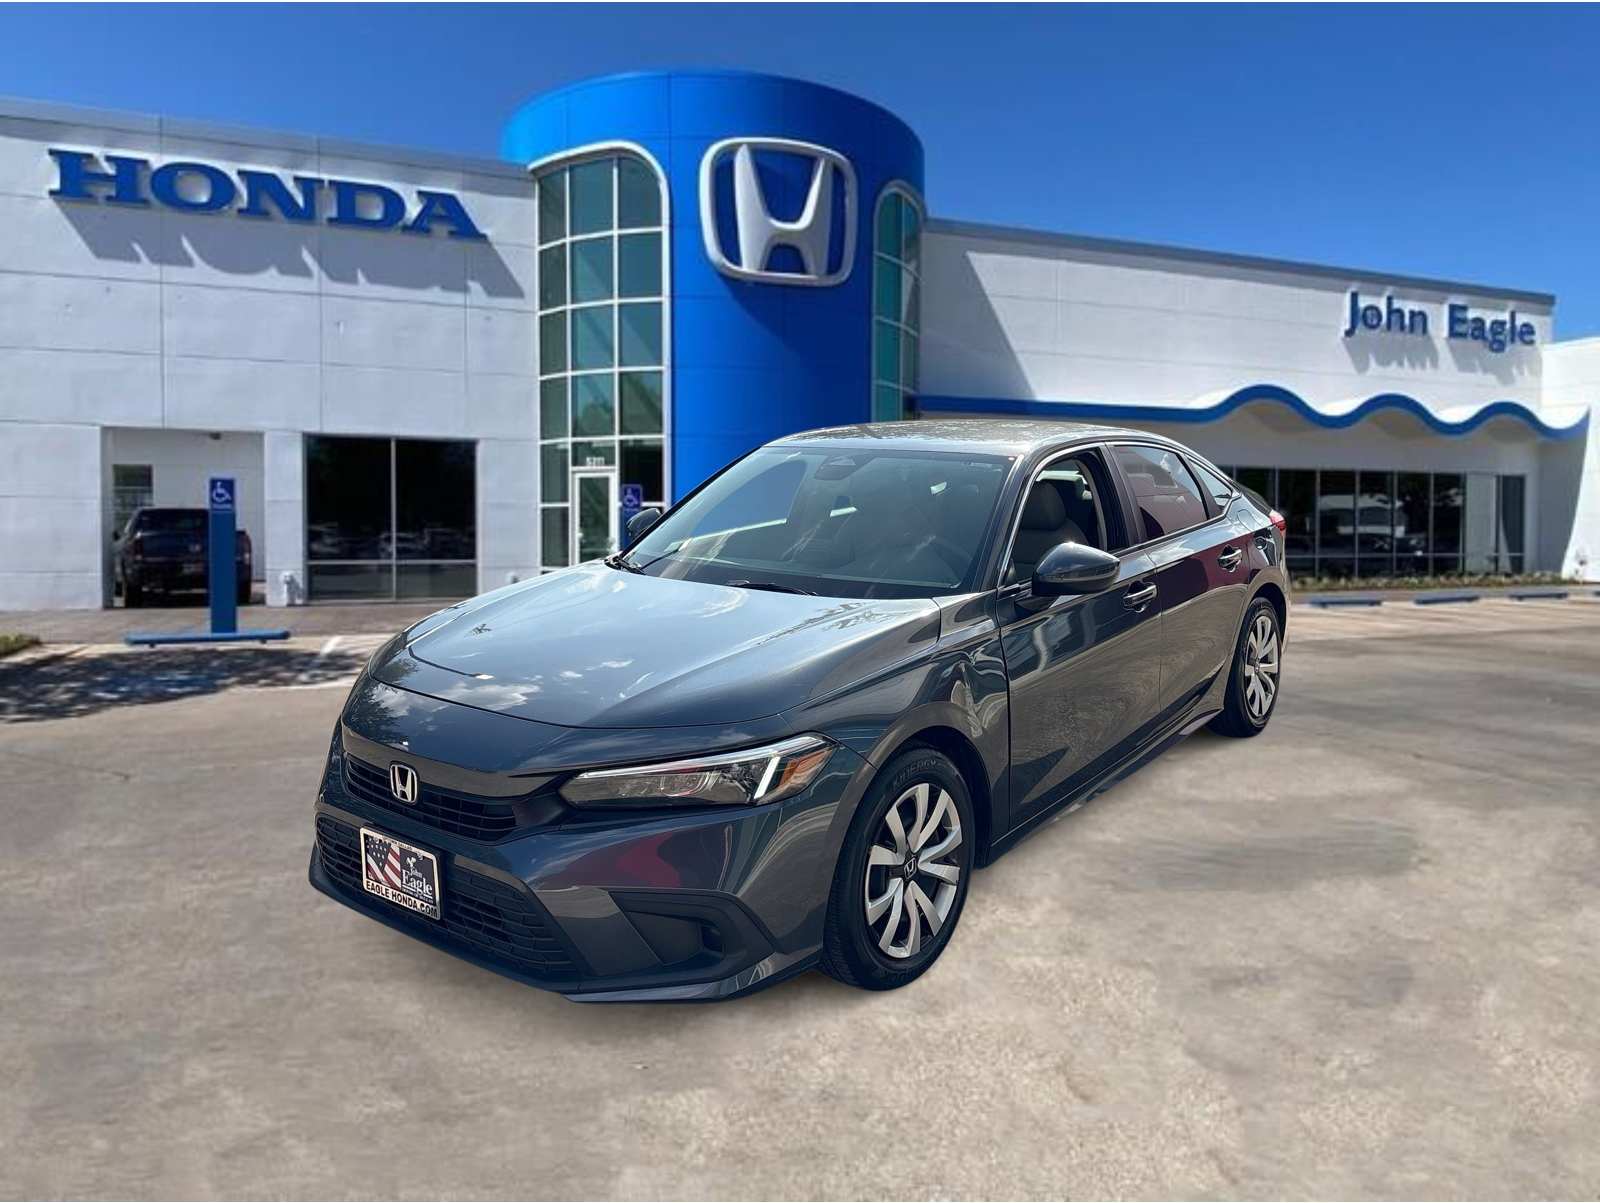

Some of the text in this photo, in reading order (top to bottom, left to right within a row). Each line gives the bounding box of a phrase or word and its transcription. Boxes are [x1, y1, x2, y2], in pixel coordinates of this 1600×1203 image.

[48, 148, 487, 240] HONDA
[1344, 291, 1536, 353] John Eagle
[366, 880, 390, 898] EAGLE
[402, 869, 433, 896] Eagle
